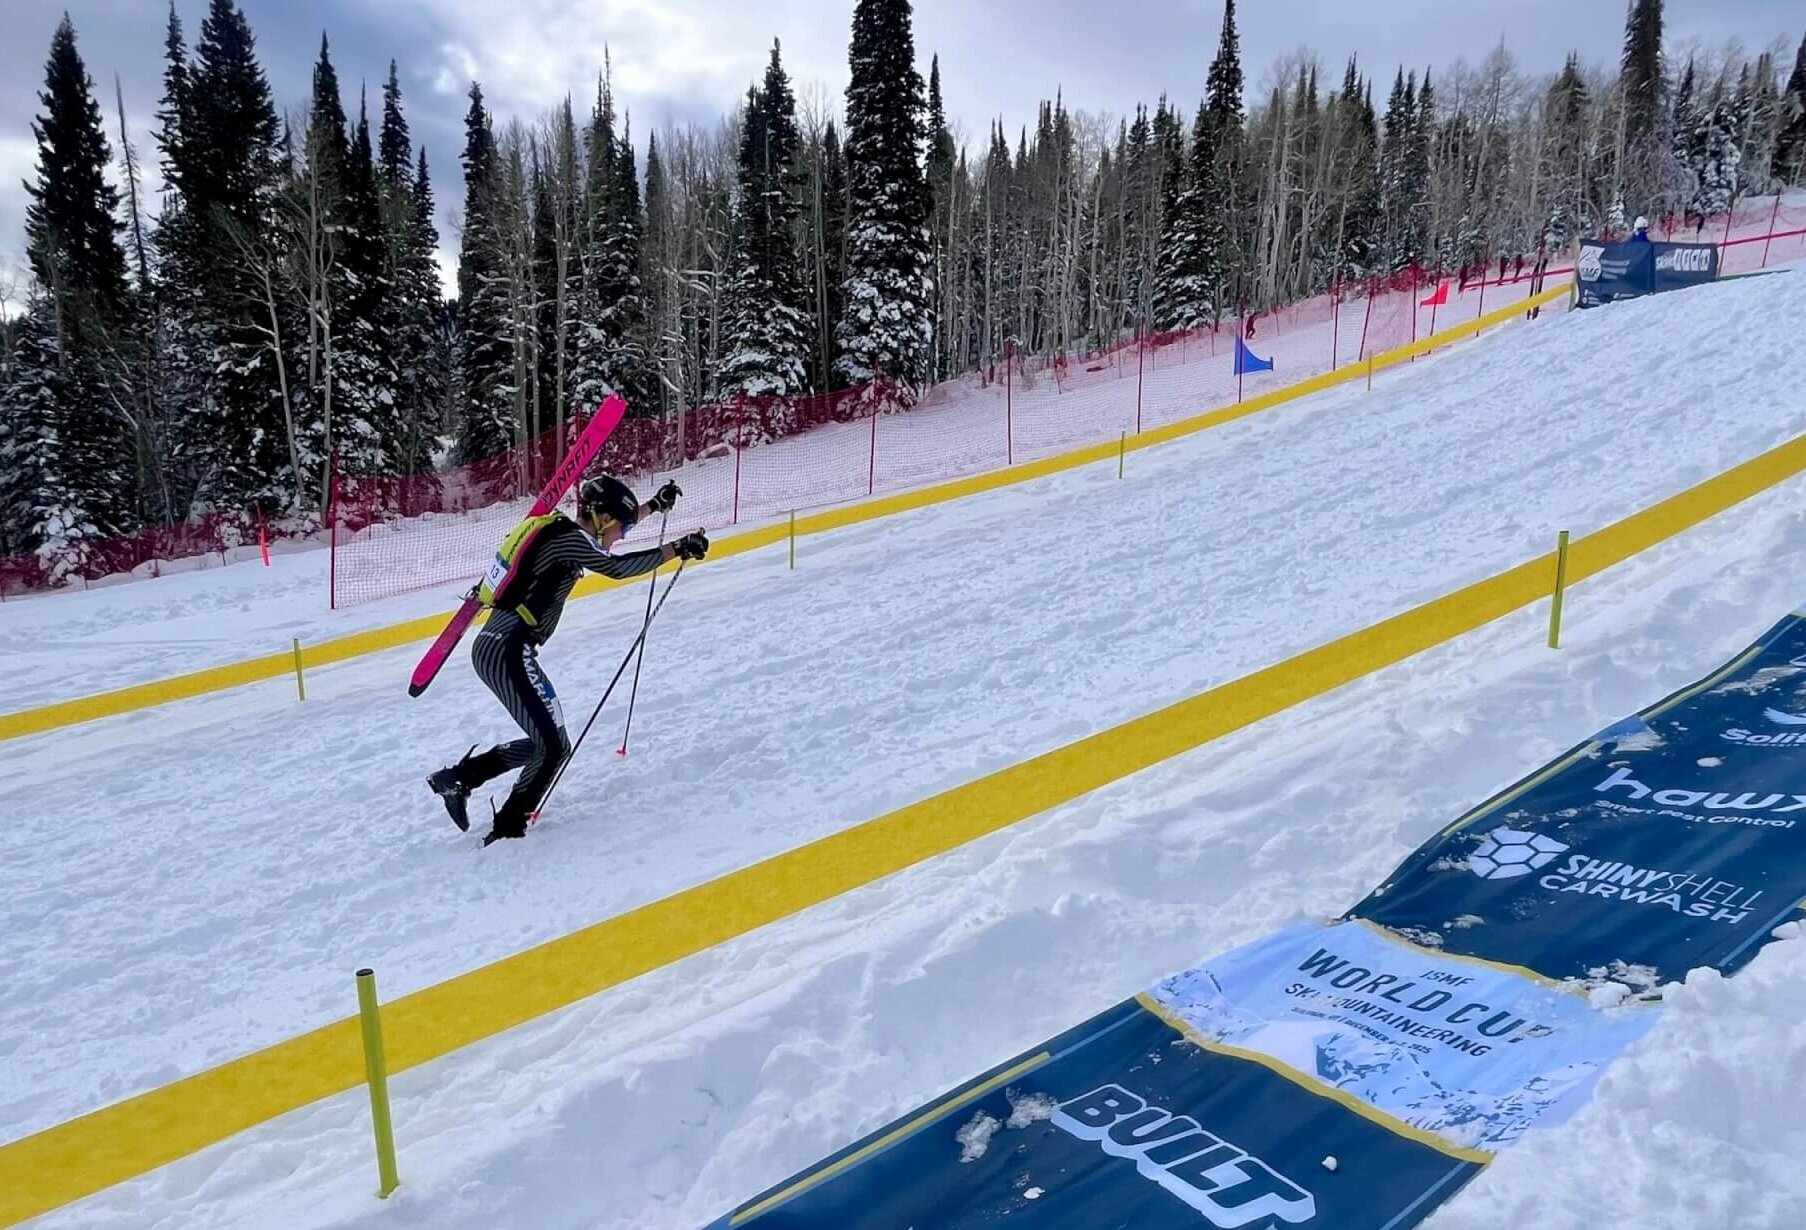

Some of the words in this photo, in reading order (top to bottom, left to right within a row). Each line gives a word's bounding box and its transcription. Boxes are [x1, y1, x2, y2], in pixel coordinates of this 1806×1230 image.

[490, 564, 500, 579] 13
[1593, 800, 1655, 814] Smart
[1657, 809, 1705, 823] Pest
[1708, 815, 1797, 829] Control
[1539, 875, 1749, 924] CARWASH
[1297, 948, 1453, 1012] WORLD
[1419, 970, 1475, 987] ISMF
[1324, 994, 1493, 1057] OUNTAINEERING
[1050, 1083, 1316, 1229] BUILT
